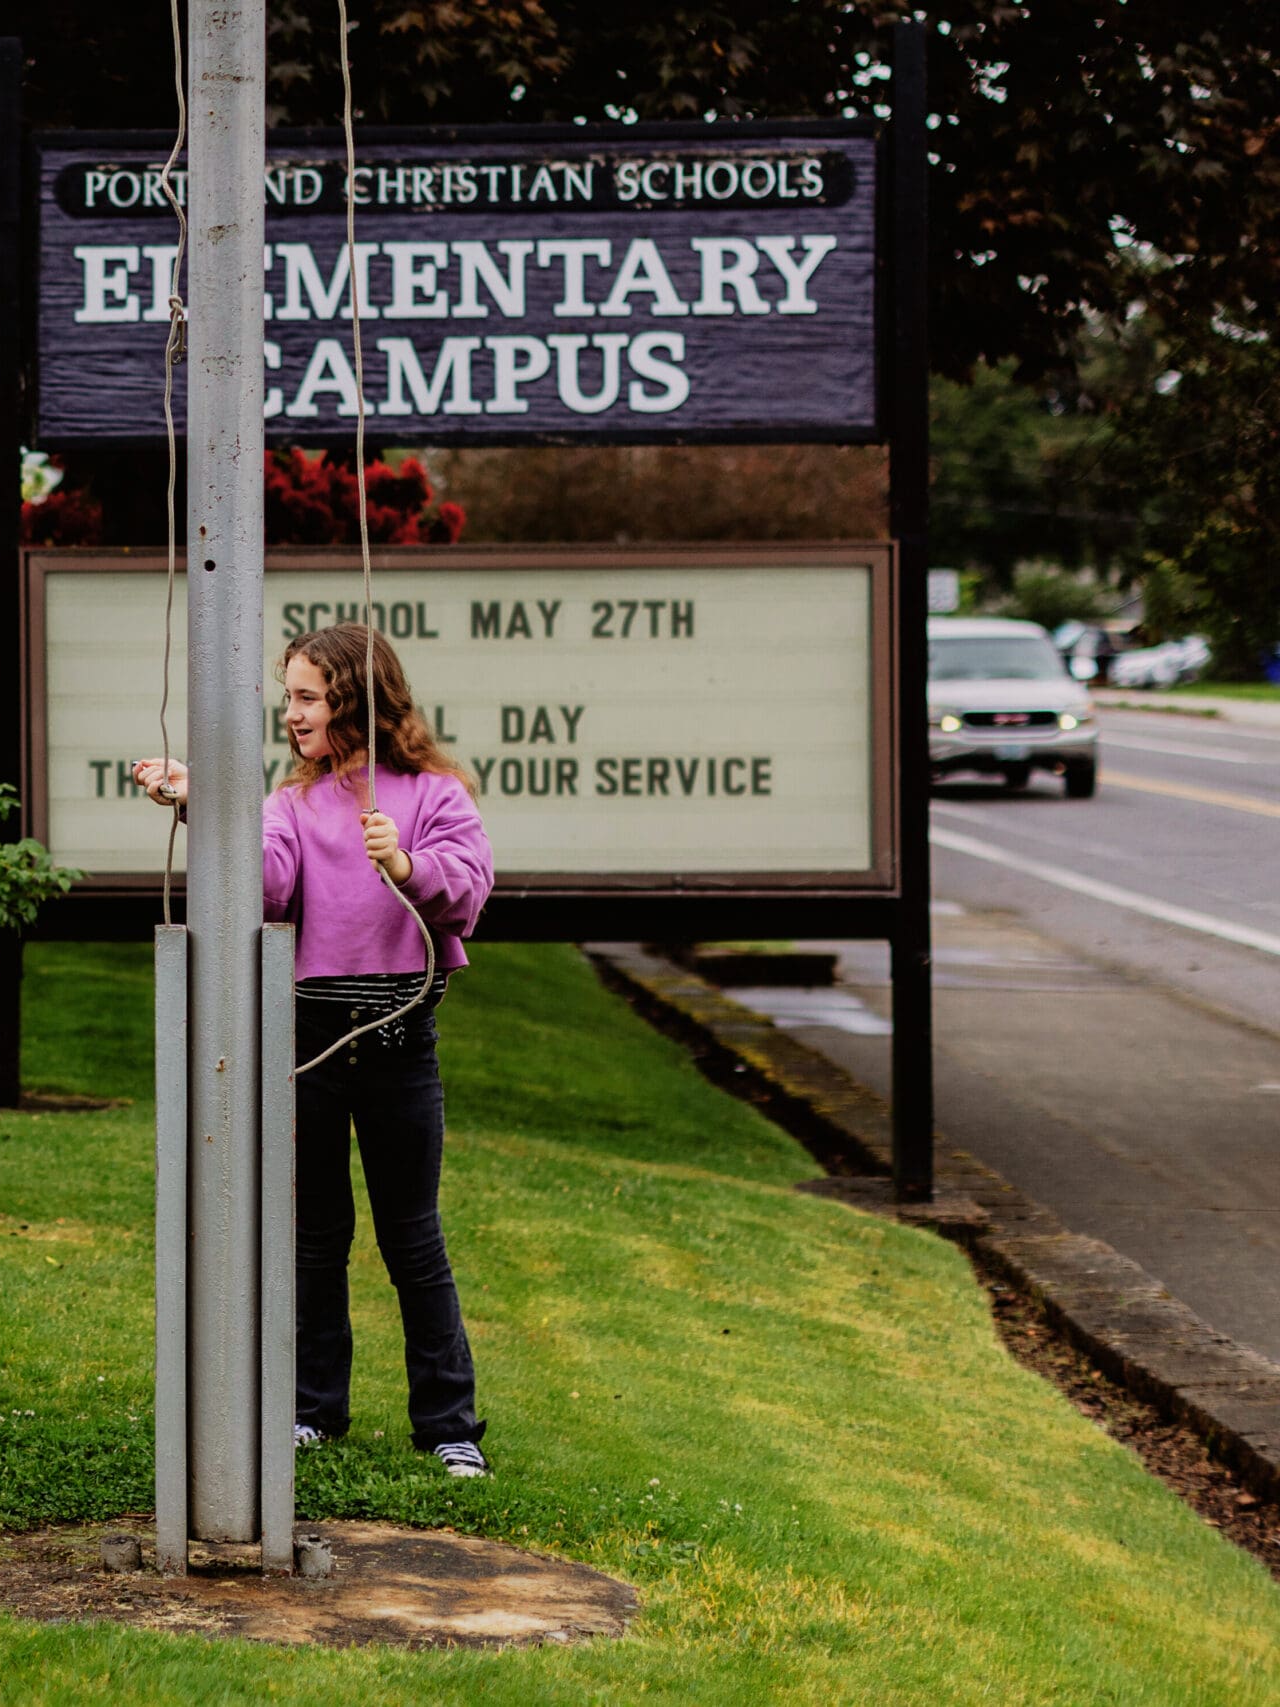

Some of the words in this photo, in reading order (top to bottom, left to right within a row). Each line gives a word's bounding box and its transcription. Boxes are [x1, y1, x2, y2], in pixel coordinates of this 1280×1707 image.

[85, 169, 323, 207] PORTND
[344, 162, 594, 204] CHRISTIAN
[616, 159, 824, 201] SCHOOLS
[73, 235, 837, 323] ELMENTARY
[263, 331, 690, 418] AMPUS
[470, 600, 562, 639] MAY
[591, 600, 695, 639] 27TH
[500, 705, 585, 744] DAY
[471, 756, 580, 796] YOUR
[594, 756, 773, 796] SERVICE
